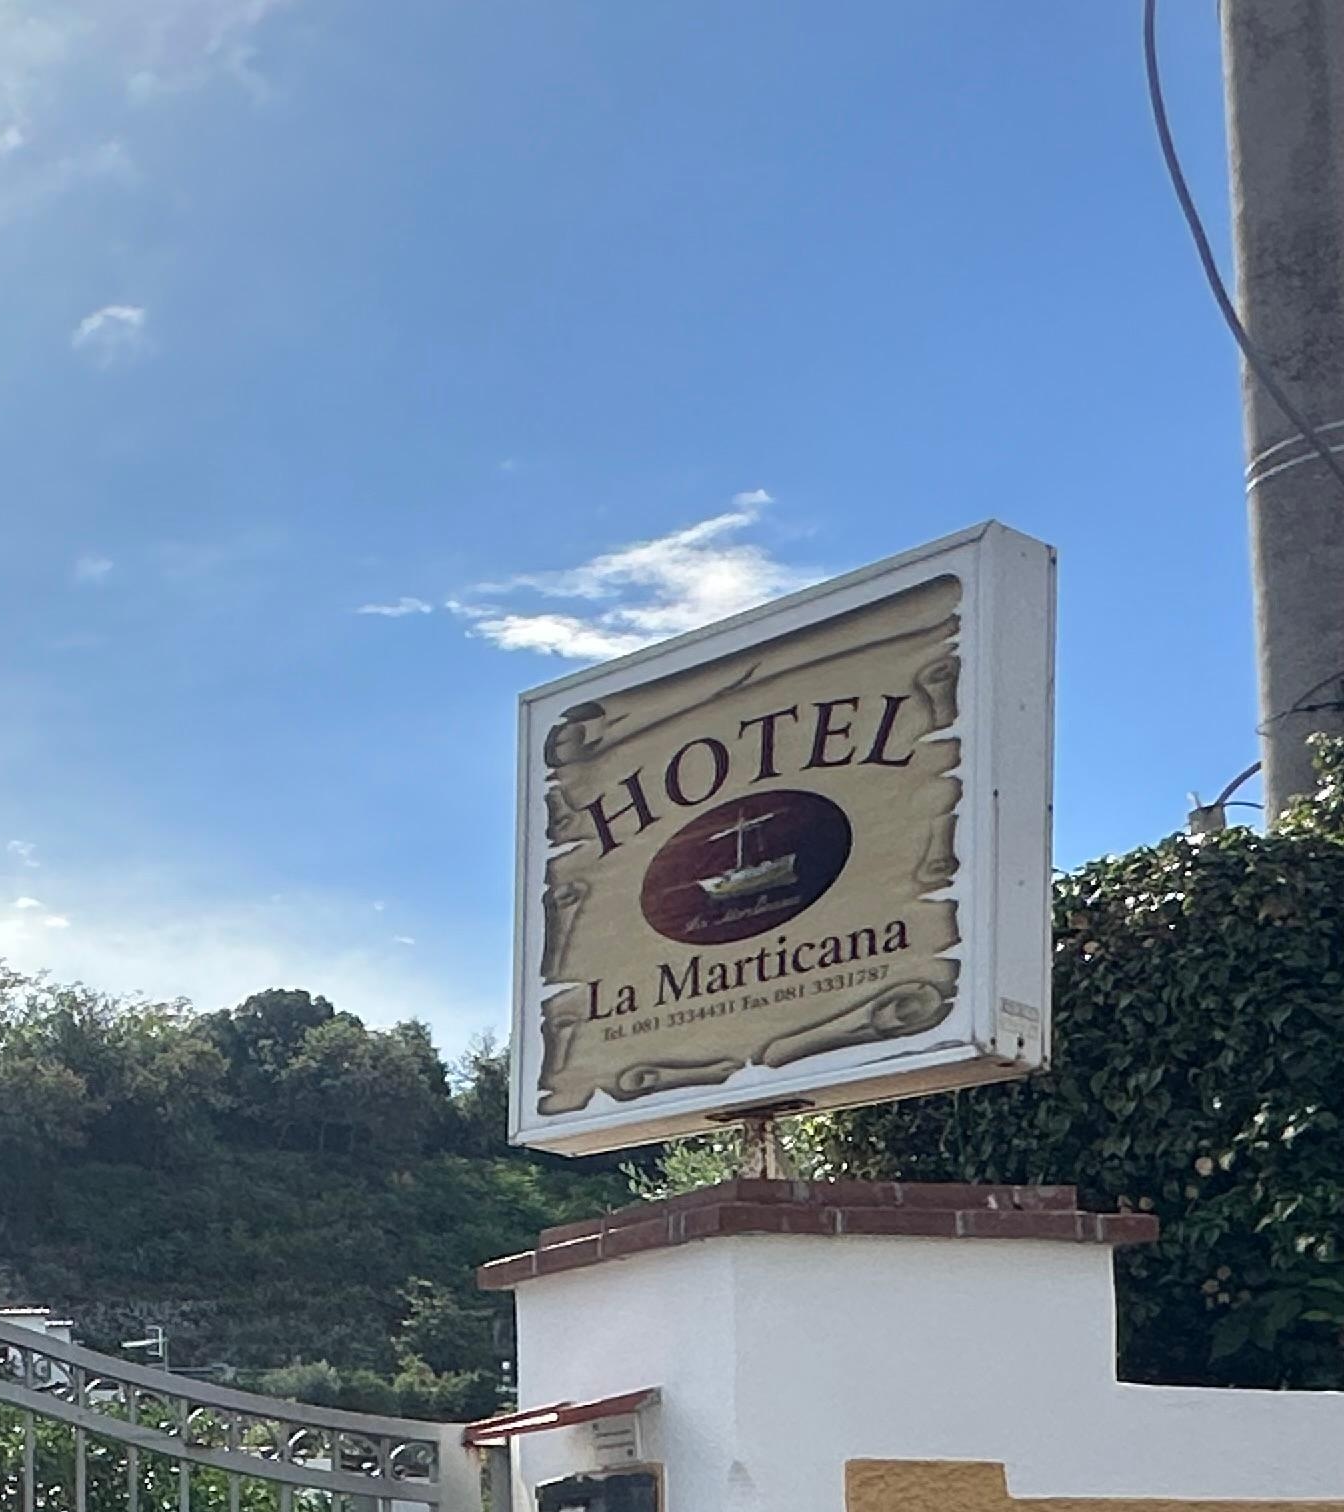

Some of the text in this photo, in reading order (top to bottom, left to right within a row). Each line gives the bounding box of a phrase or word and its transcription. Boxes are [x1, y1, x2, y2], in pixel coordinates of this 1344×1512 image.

[582, 694, 916, 858] HOTEL
[584, 919, 911, 1023] La Marticana
[632, 1016, 661, 1036] 081
[741, 994, 770, 1011] Fax
[774, 983, 806, 1003] 081
